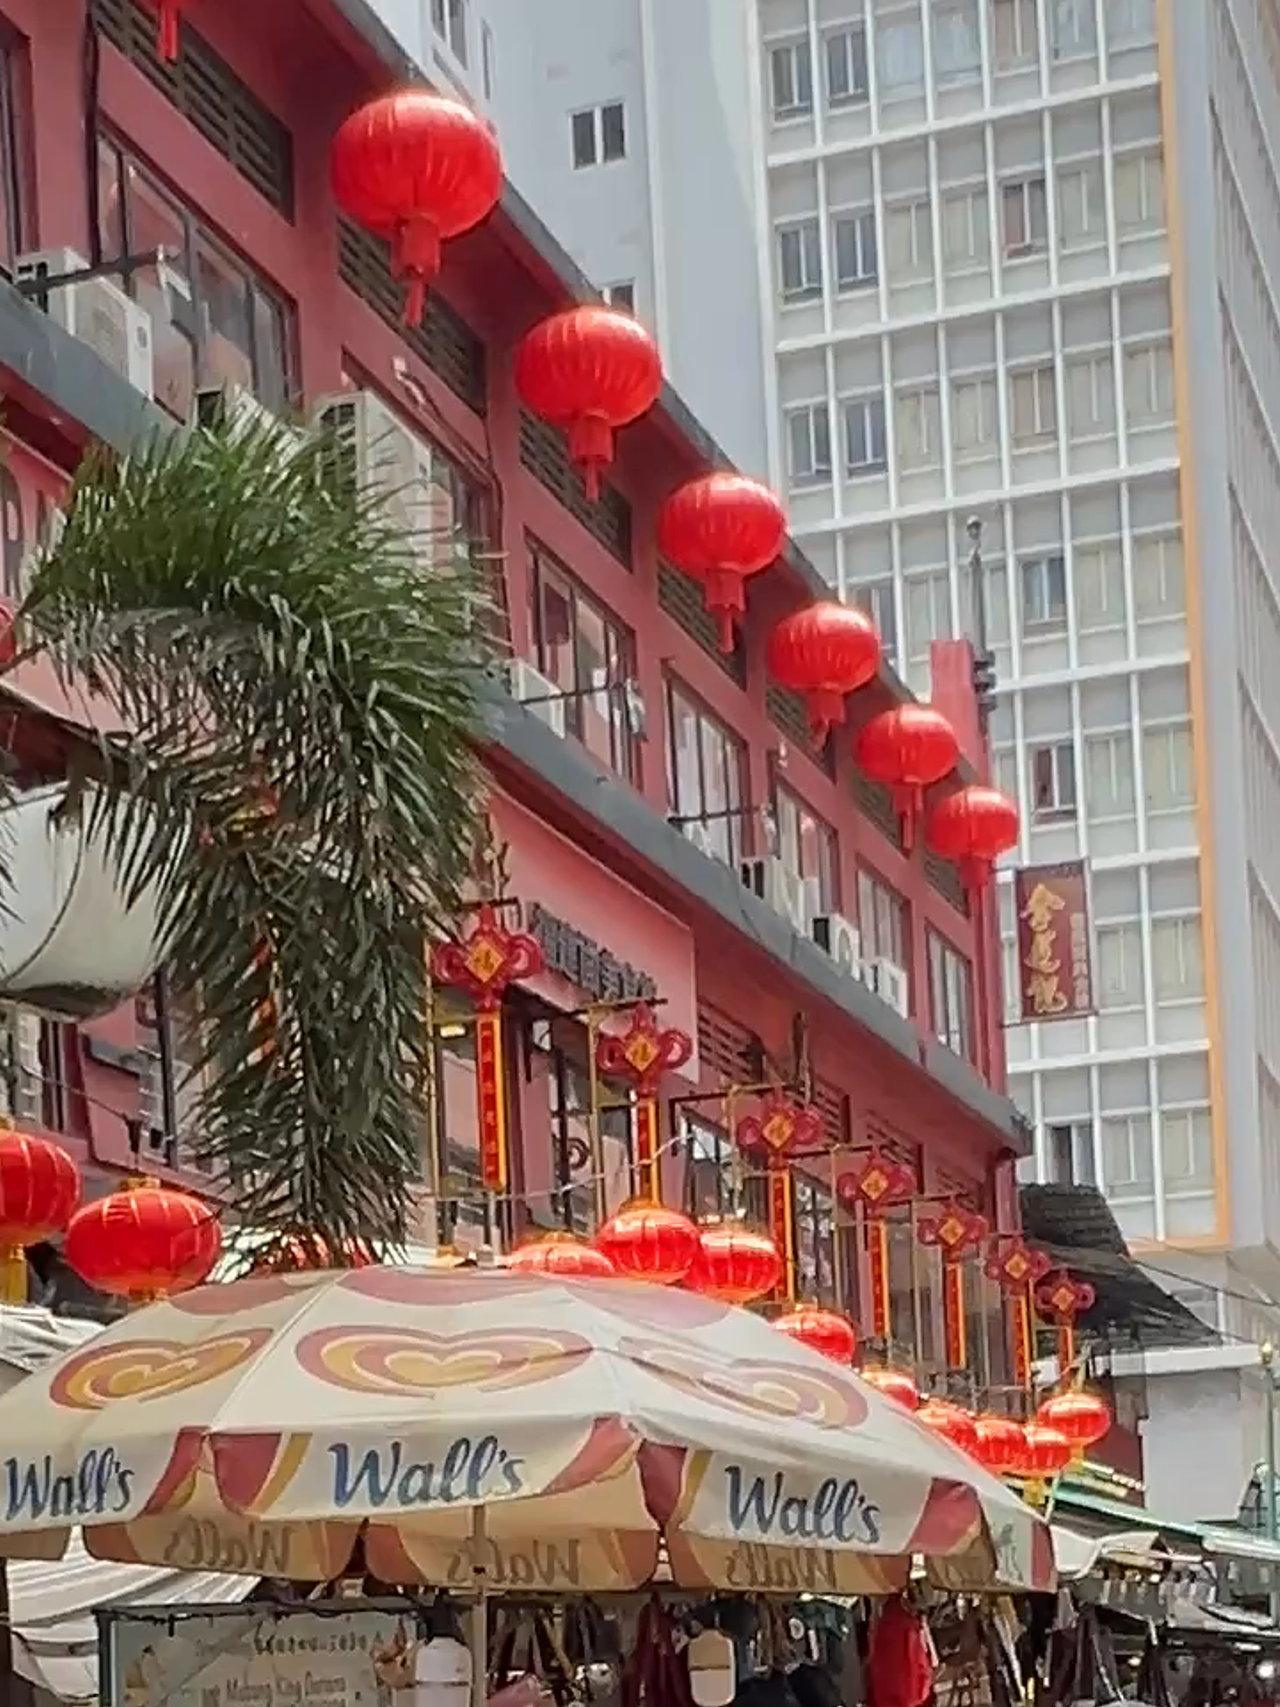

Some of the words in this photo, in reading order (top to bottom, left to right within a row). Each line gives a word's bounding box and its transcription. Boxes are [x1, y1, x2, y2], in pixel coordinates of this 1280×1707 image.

[5, 1447, 135, 1522] Wall's
[328, 1435, 525, 1507] Wall's
[724, 1465, 881, 1544] Wall's
